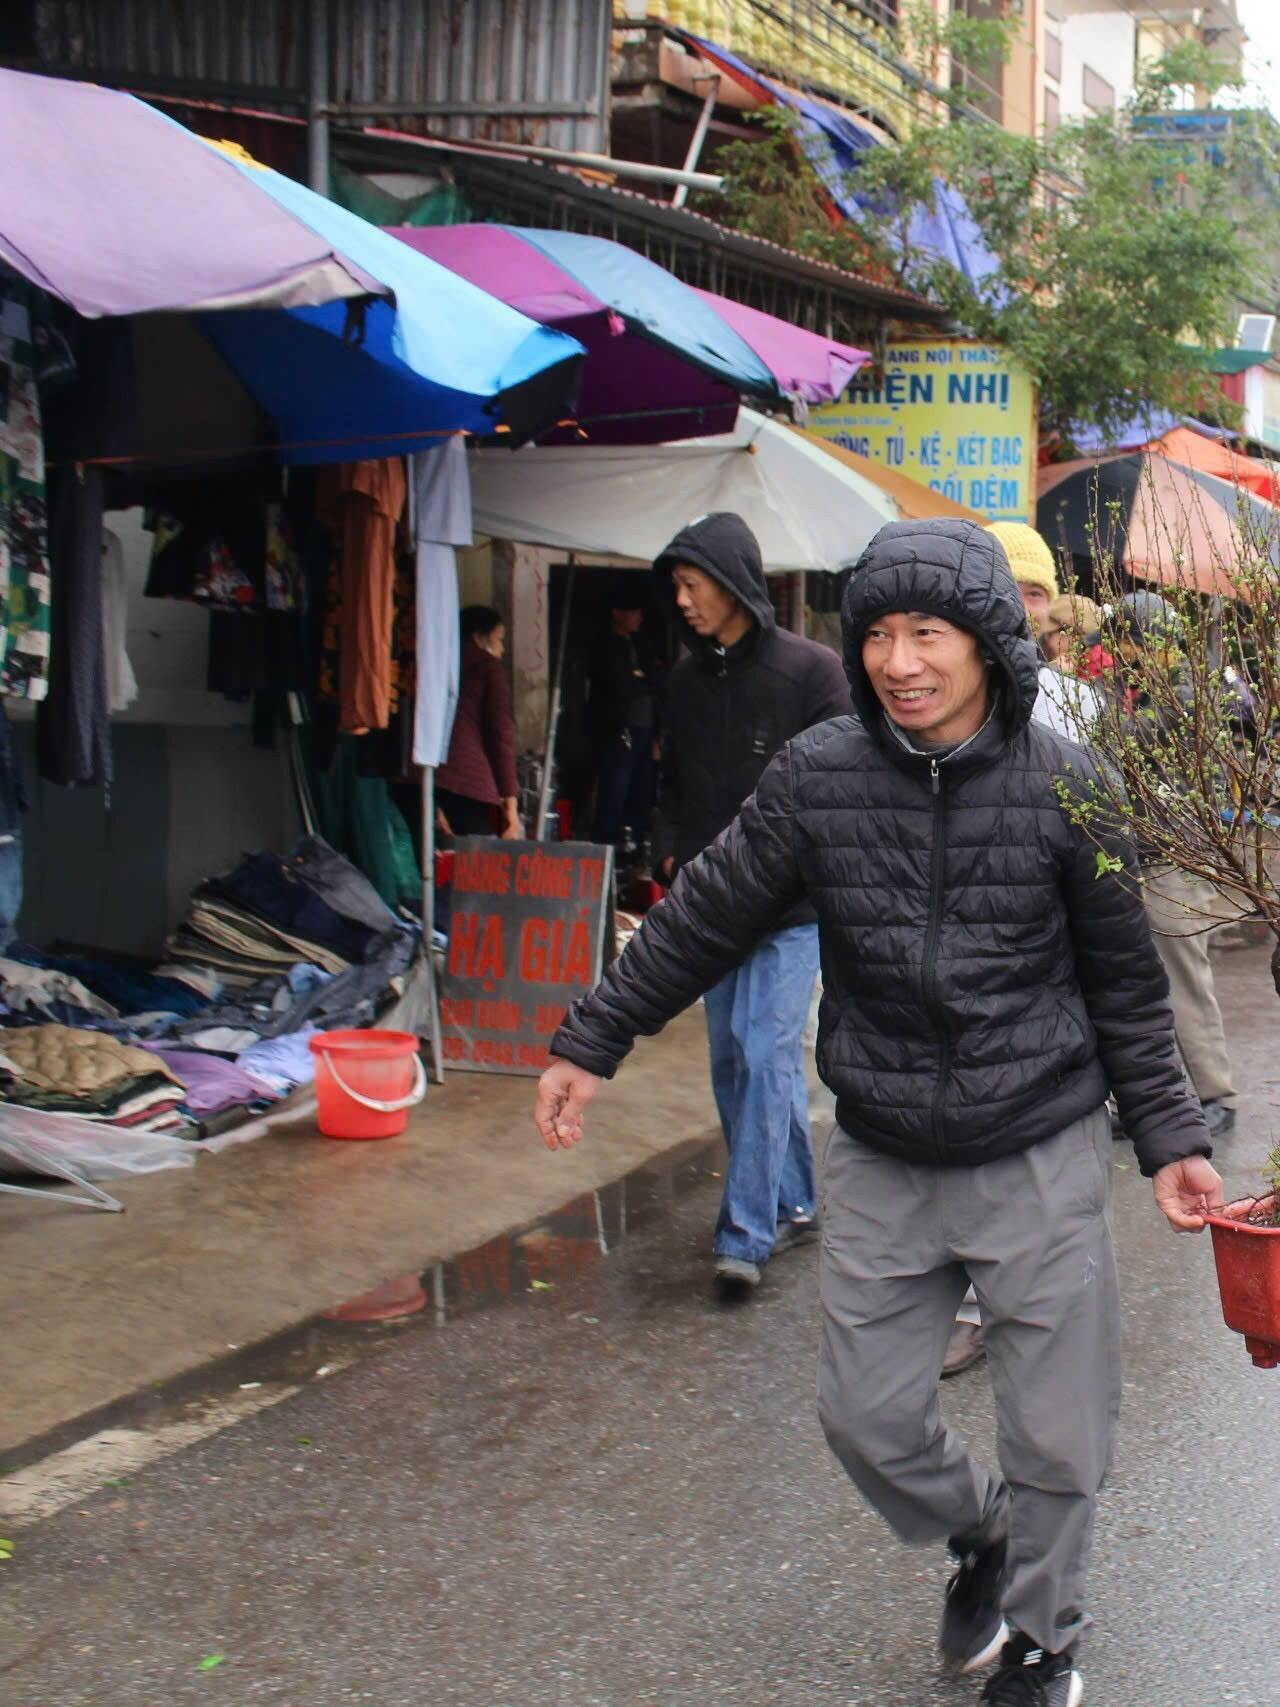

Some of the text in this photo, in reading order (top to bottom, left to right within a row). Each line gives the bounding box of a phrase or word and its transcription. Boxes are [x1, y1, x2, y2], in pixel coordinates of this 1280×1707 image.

[948, 374, 1009, 411] NHỊ
[991, 436, 1023, 472] BẠC
[448, 907, 591, 992] HẠ GIÁ
